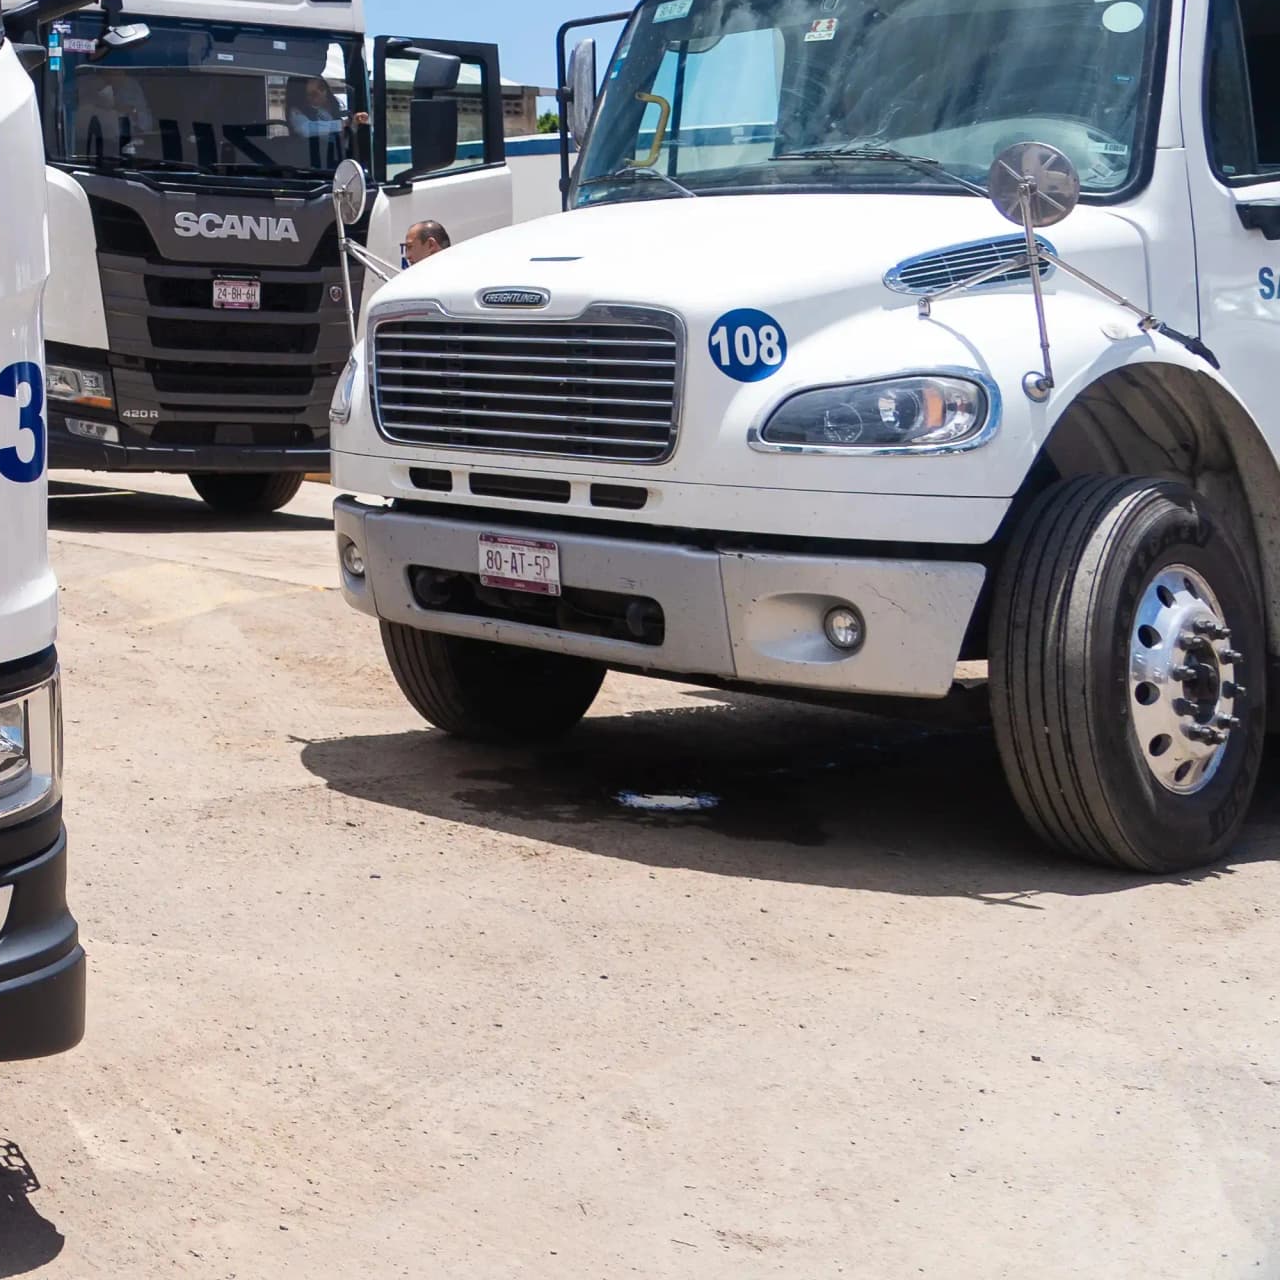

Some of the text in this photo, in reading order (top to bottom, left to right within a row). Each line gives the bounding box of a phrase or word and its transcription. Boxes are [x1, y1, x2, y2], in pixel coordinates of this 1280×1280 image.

[174, 211, 300, 242] SCANIA
[483, 292, 541, 304] FREIGHTLINER
[1258, 266, 1280, 300] S
[711, 324, 782, 366] 108
[122, 409, 159, 418] 420 R
[486, 549, 551, 578] 80-AT-5P
